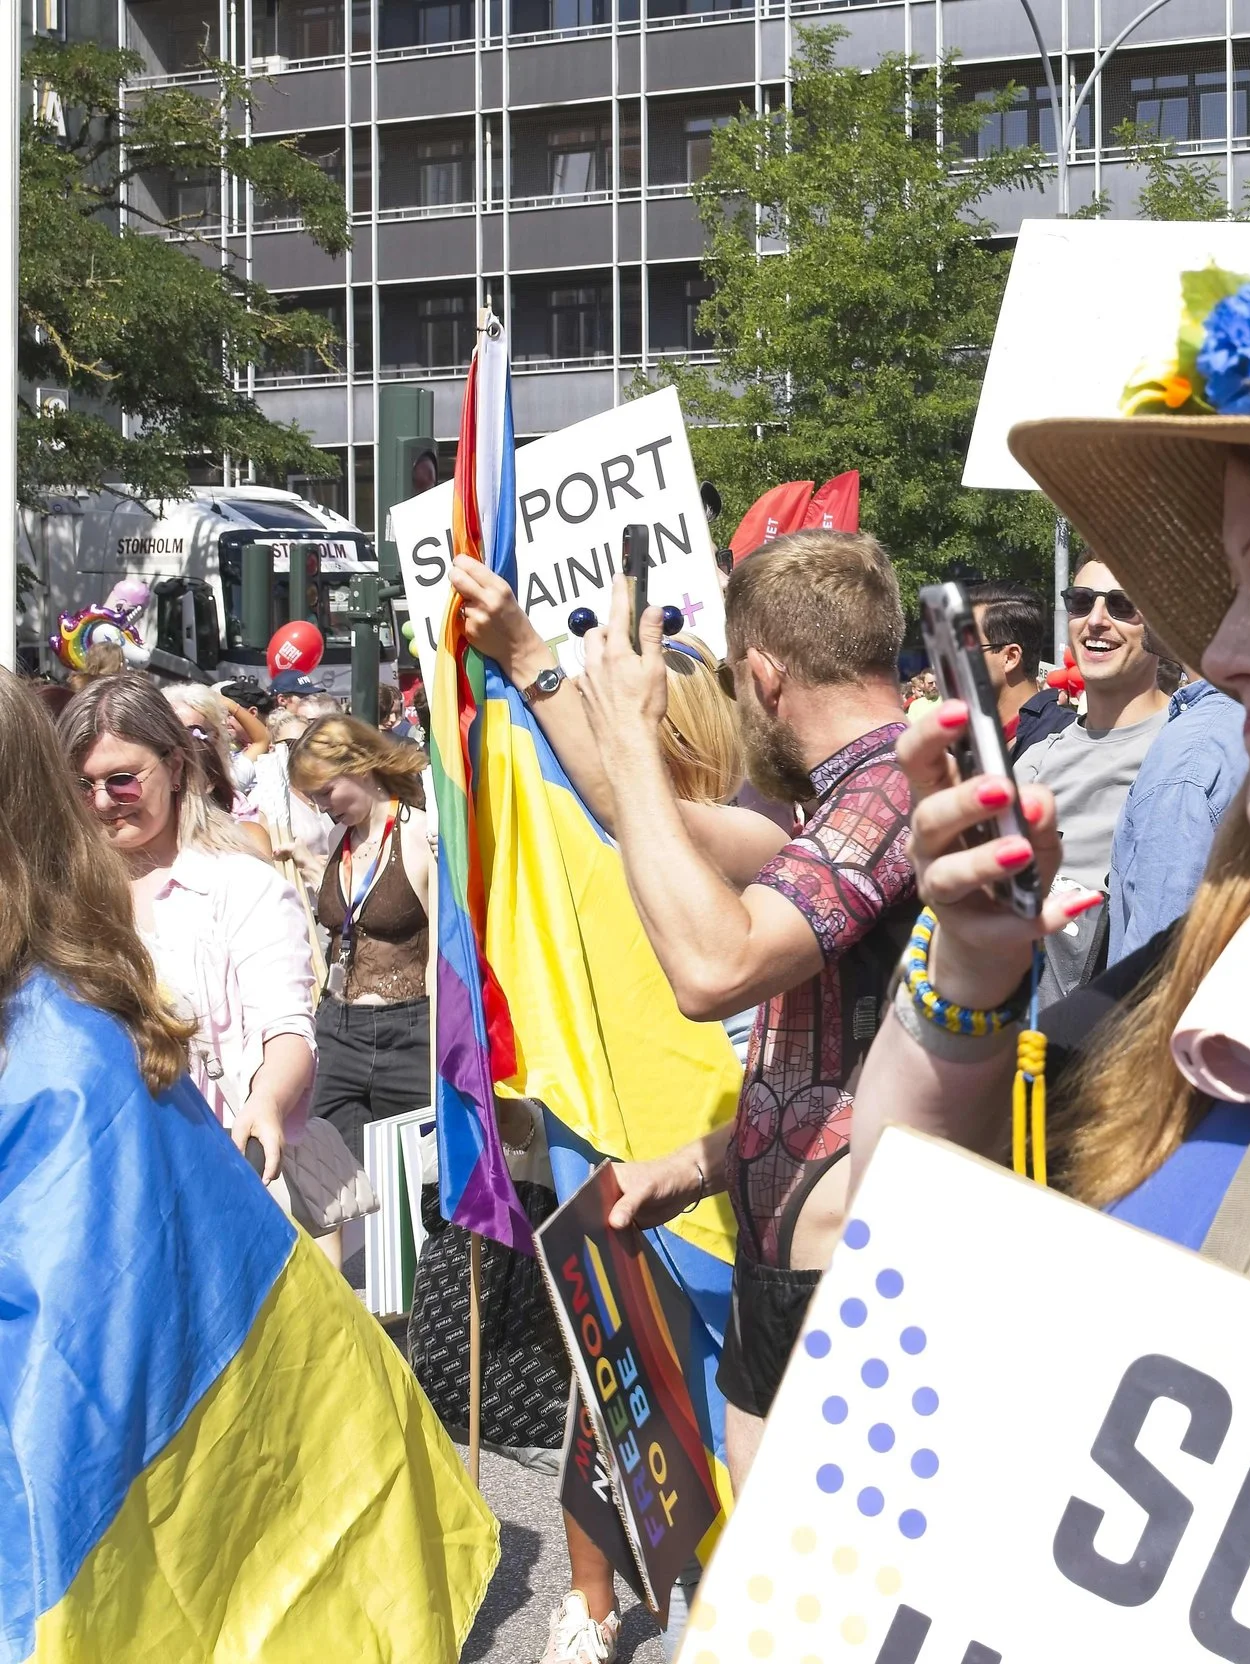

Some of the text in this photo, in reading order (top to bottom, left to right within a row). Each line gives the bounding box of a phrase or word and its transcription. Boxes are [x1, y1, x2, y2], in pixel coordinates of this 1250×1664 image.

[117, 538, 183, 554] STOKHOLM
[616, 1346, 678, 1528] TO BE
